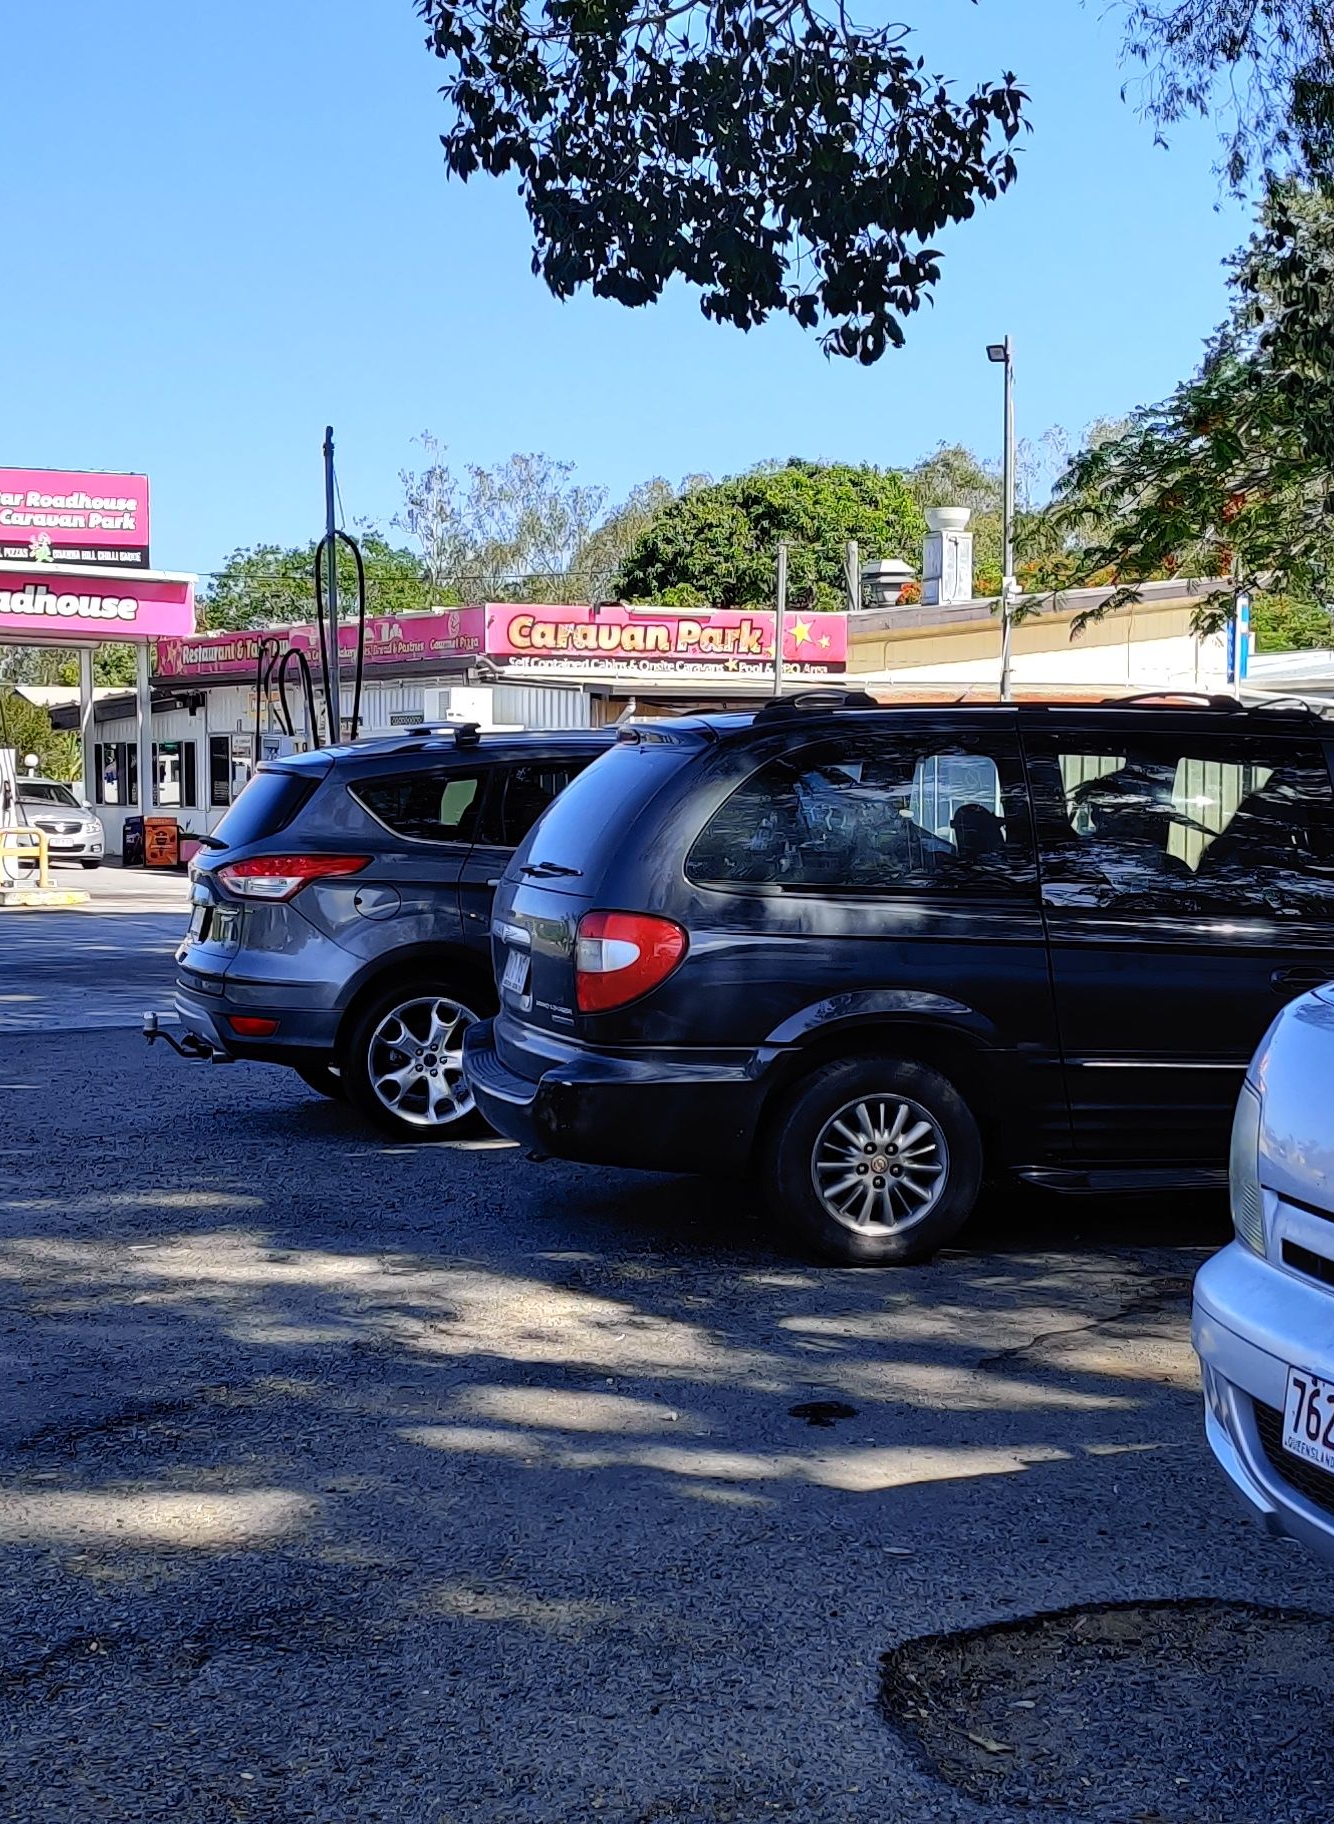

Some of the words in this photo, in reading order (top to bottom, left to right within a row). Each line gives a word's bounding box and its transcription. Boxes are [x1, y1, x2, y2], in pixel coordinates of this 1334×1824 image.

[26, 490, 137, 511] Roadhouse
[88, 511, 136, 530] Park
[507, 614, 671, 653] Caravan
[676, 618, 764, 655] Park
[182, 640, 235, 665] Restaurant
[509, 656, 530, 667] Self
[530, 657, 590, 669] Contained
[591, 658, 627, 670] Cabins
[639, 660, 674, 672] Onsite
[676, 661, 724, 672] Caravans
[738, 662, 763, 673] Pool
